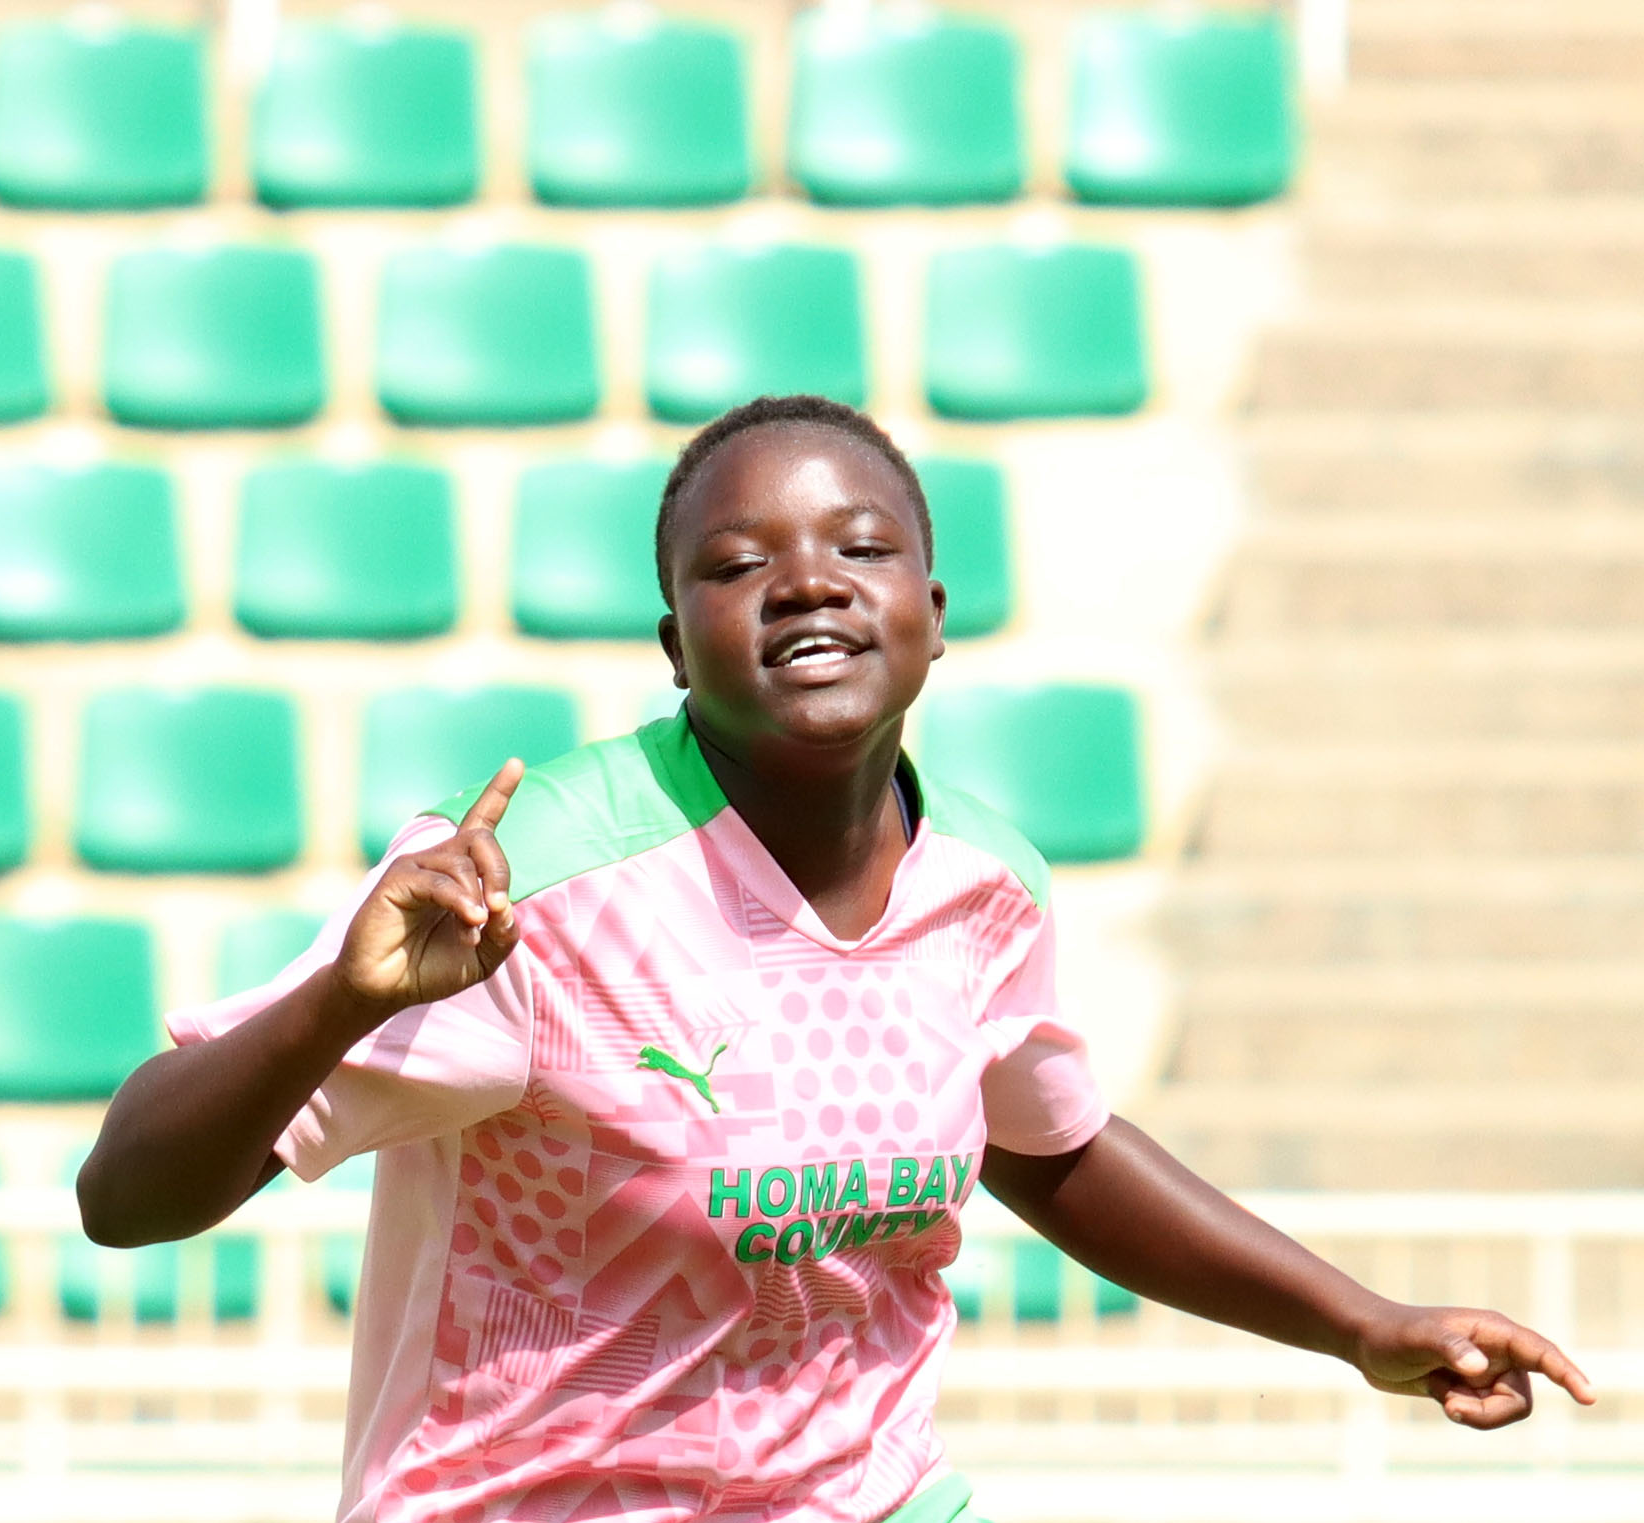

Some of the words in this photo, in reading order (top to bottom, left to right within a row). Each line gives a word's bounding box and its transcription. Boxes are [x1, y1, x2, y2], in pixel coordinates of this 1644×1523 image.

[708, 1158, 869, 1218] HOMA
[887, 1152, 974, 1207] BAY
[734, 1208, 949, 1265] COUNTY
